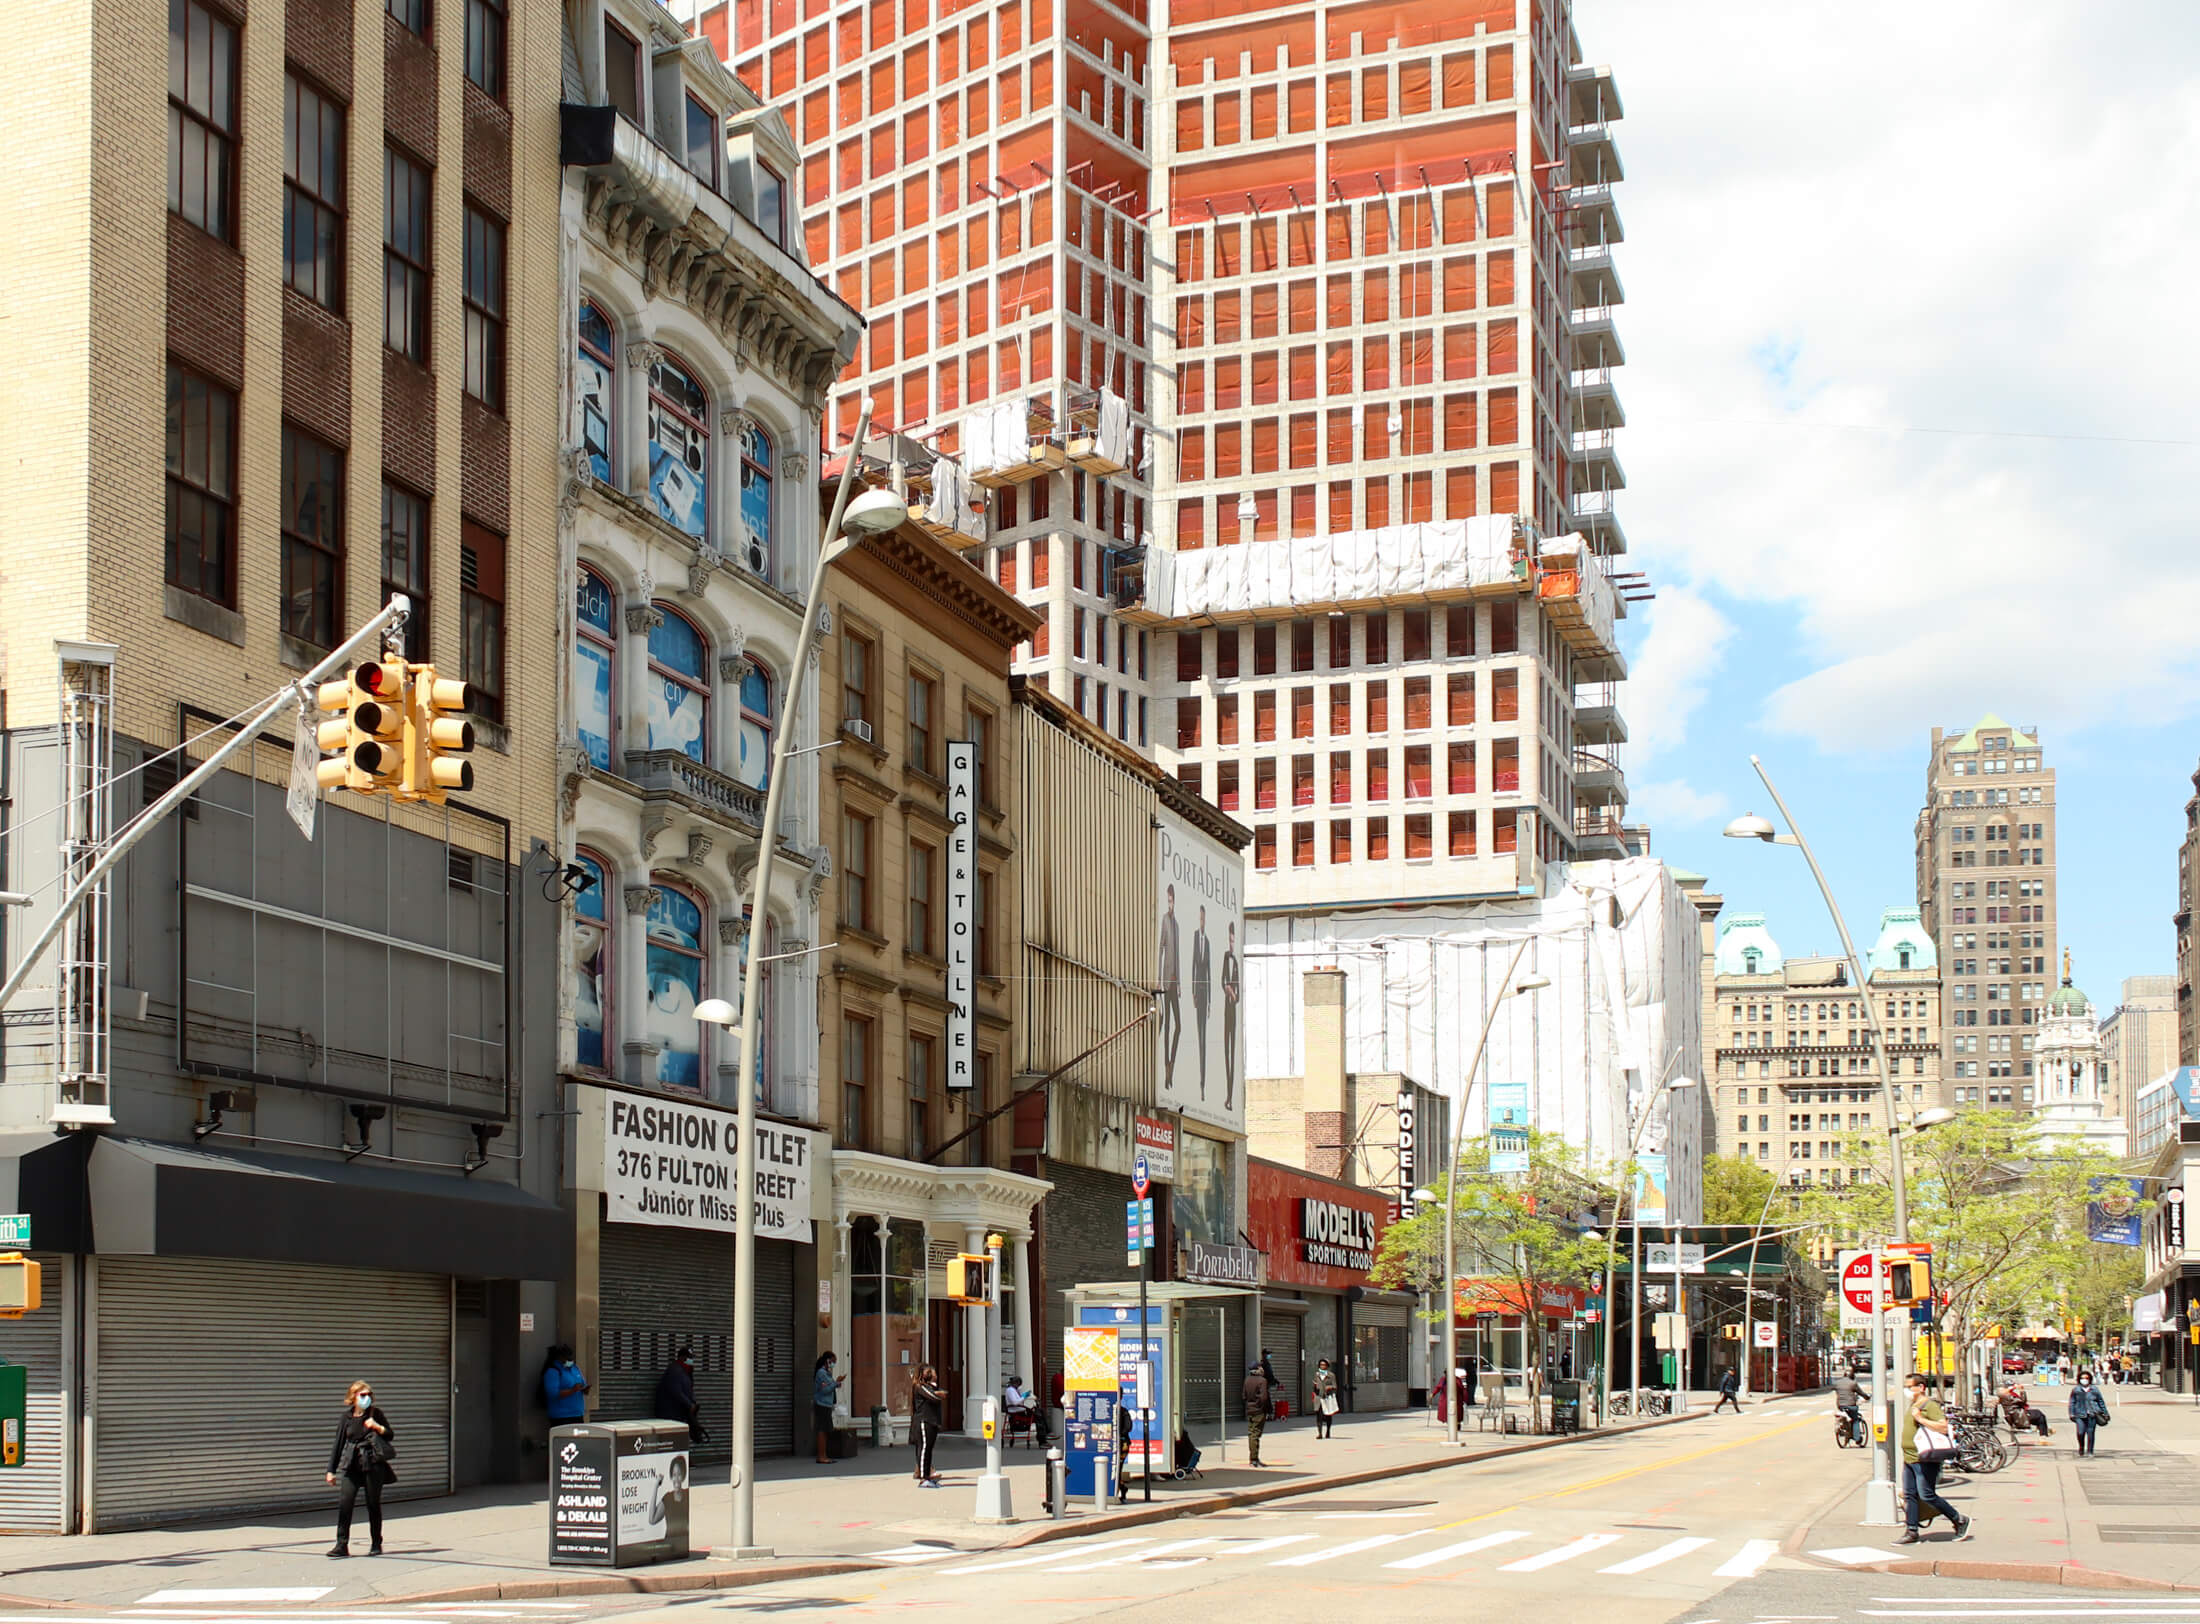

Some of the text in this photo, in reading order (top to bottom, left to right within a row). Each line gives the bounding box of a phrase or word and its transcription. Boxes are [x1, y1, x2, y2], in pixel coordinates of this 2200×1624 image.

[954, 756, 967, 1075] GAGE & TOLLNER
[612, 1100, 807, 1167] FASHION OTLET
[1136, 1122, 1173, 1145] FOR LEASE
[617, 1149, 797, 1200] 376 FULTON REET
[638, 1186, 785, 1228] Junior Miss Plus
[1305, 1198, 1375, 1251] MODELL'S
[1308, 1243, 1374, 1271] SPORTING GOODS
[1853, 1264, 1869, 1275] DO
[1856, 1293, 1893, 1304] ENR
[1884, 1316, 1902, 1325] USES
[557, 1495, 608, 1508] ASHLAND
[621, 1486, 638, 1499] LOSE
[556, 1510, 608, 1523] & DEKALB
[621, 1502, 649, 1516] WEIGHT
